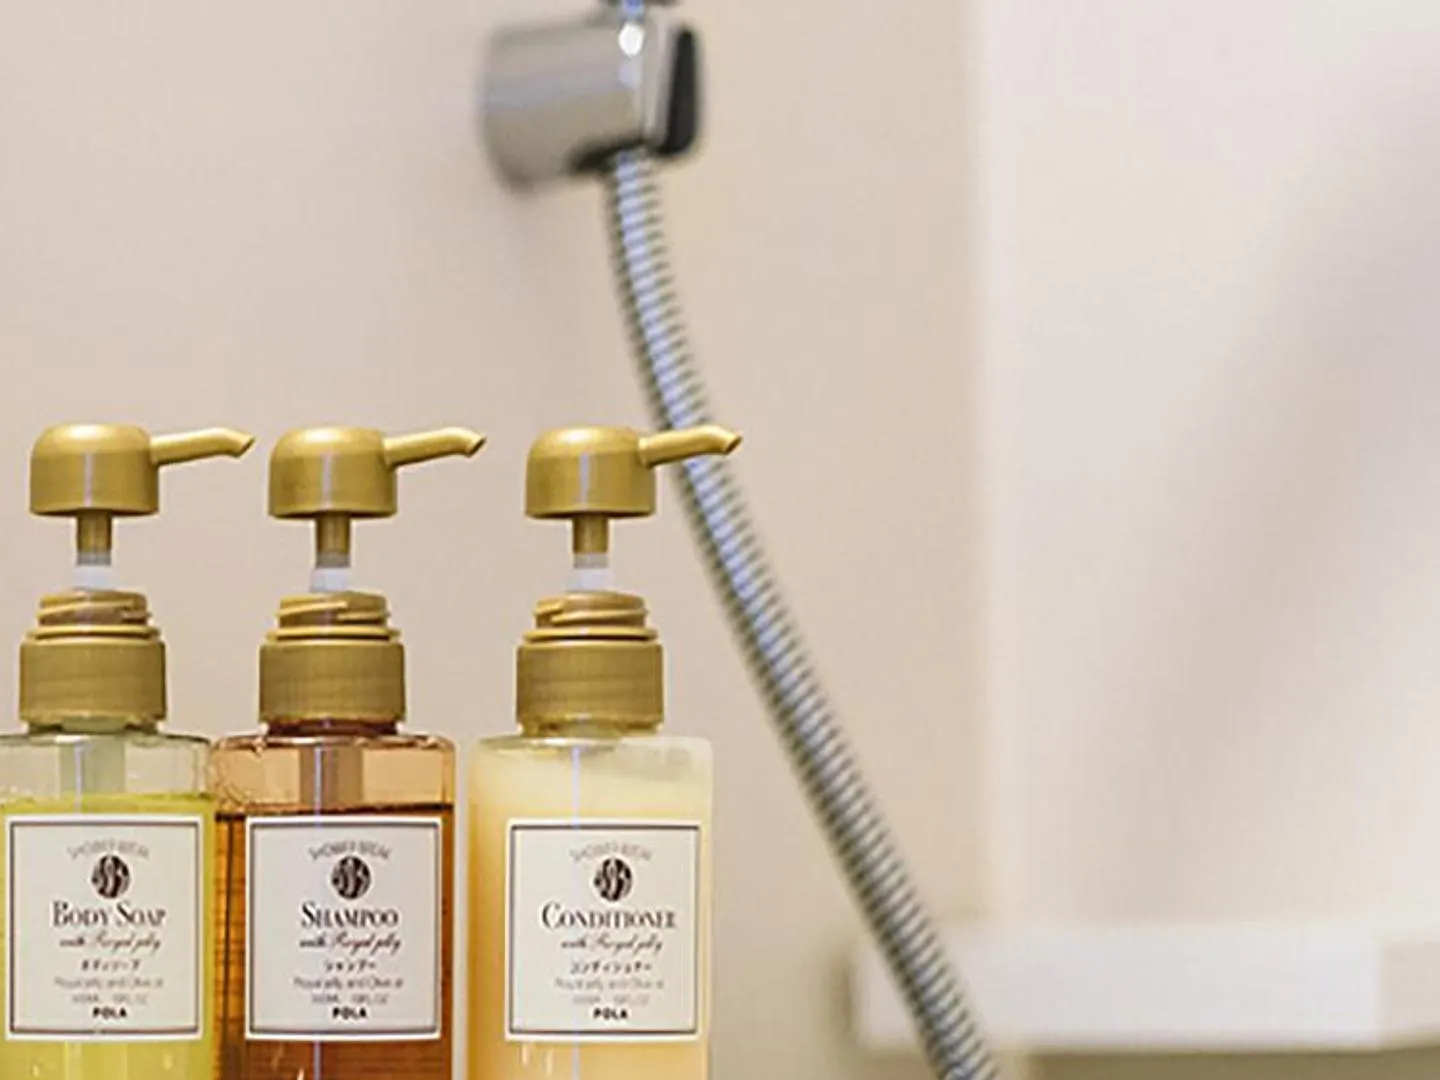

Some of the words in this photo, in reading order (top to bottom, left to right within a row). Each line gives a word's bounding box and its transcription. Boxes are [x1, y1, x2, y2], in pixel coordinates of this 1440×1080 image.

[301, 900, 400, 928] SHAMPOO
[541, 901, 677, 929] CONDITIONER
[92, 1006, 127, 1020] POLA
[332, 1006, 367, 1020] POLA
[593, 1007, 629, 1020] POLA
